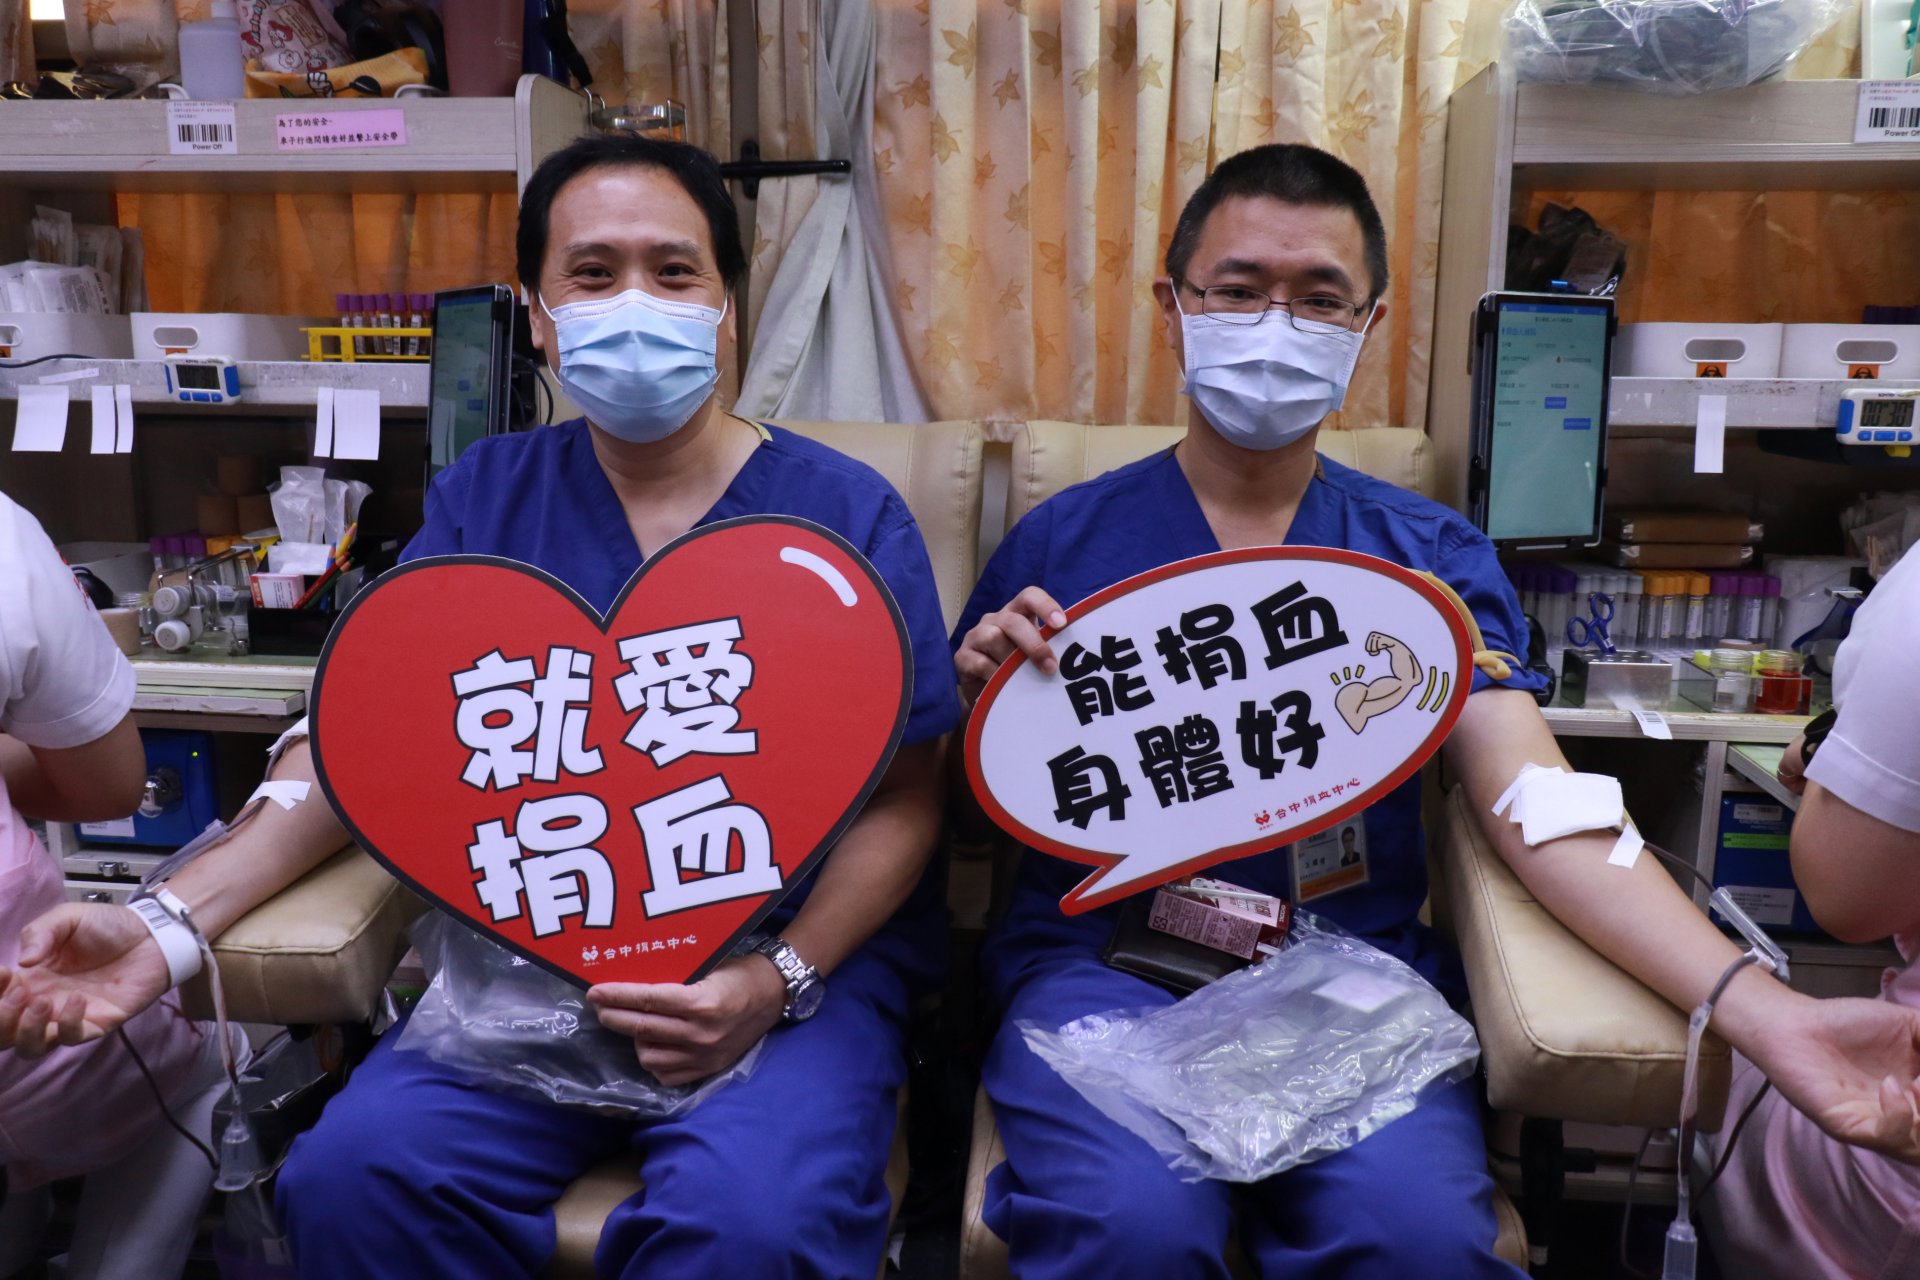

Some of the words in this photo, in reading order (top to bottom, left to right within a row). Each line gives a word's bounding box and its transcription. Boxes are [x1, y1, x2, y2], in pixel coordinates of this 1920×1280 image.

[1884, 129, 1908, 137] Power
[1910, 129, 1920, 137] Of
[451, 616, 760, 793] 就愛
[1059, 580, 1350, 727] 能捐血
[1046, 690, 1326, 831] 身體好
[1274, 776, 1361, 821] 台中捐血中心
[465, 773, 784, 941] 捐血
[602, 933, 698, 961] 台中捐血中心
